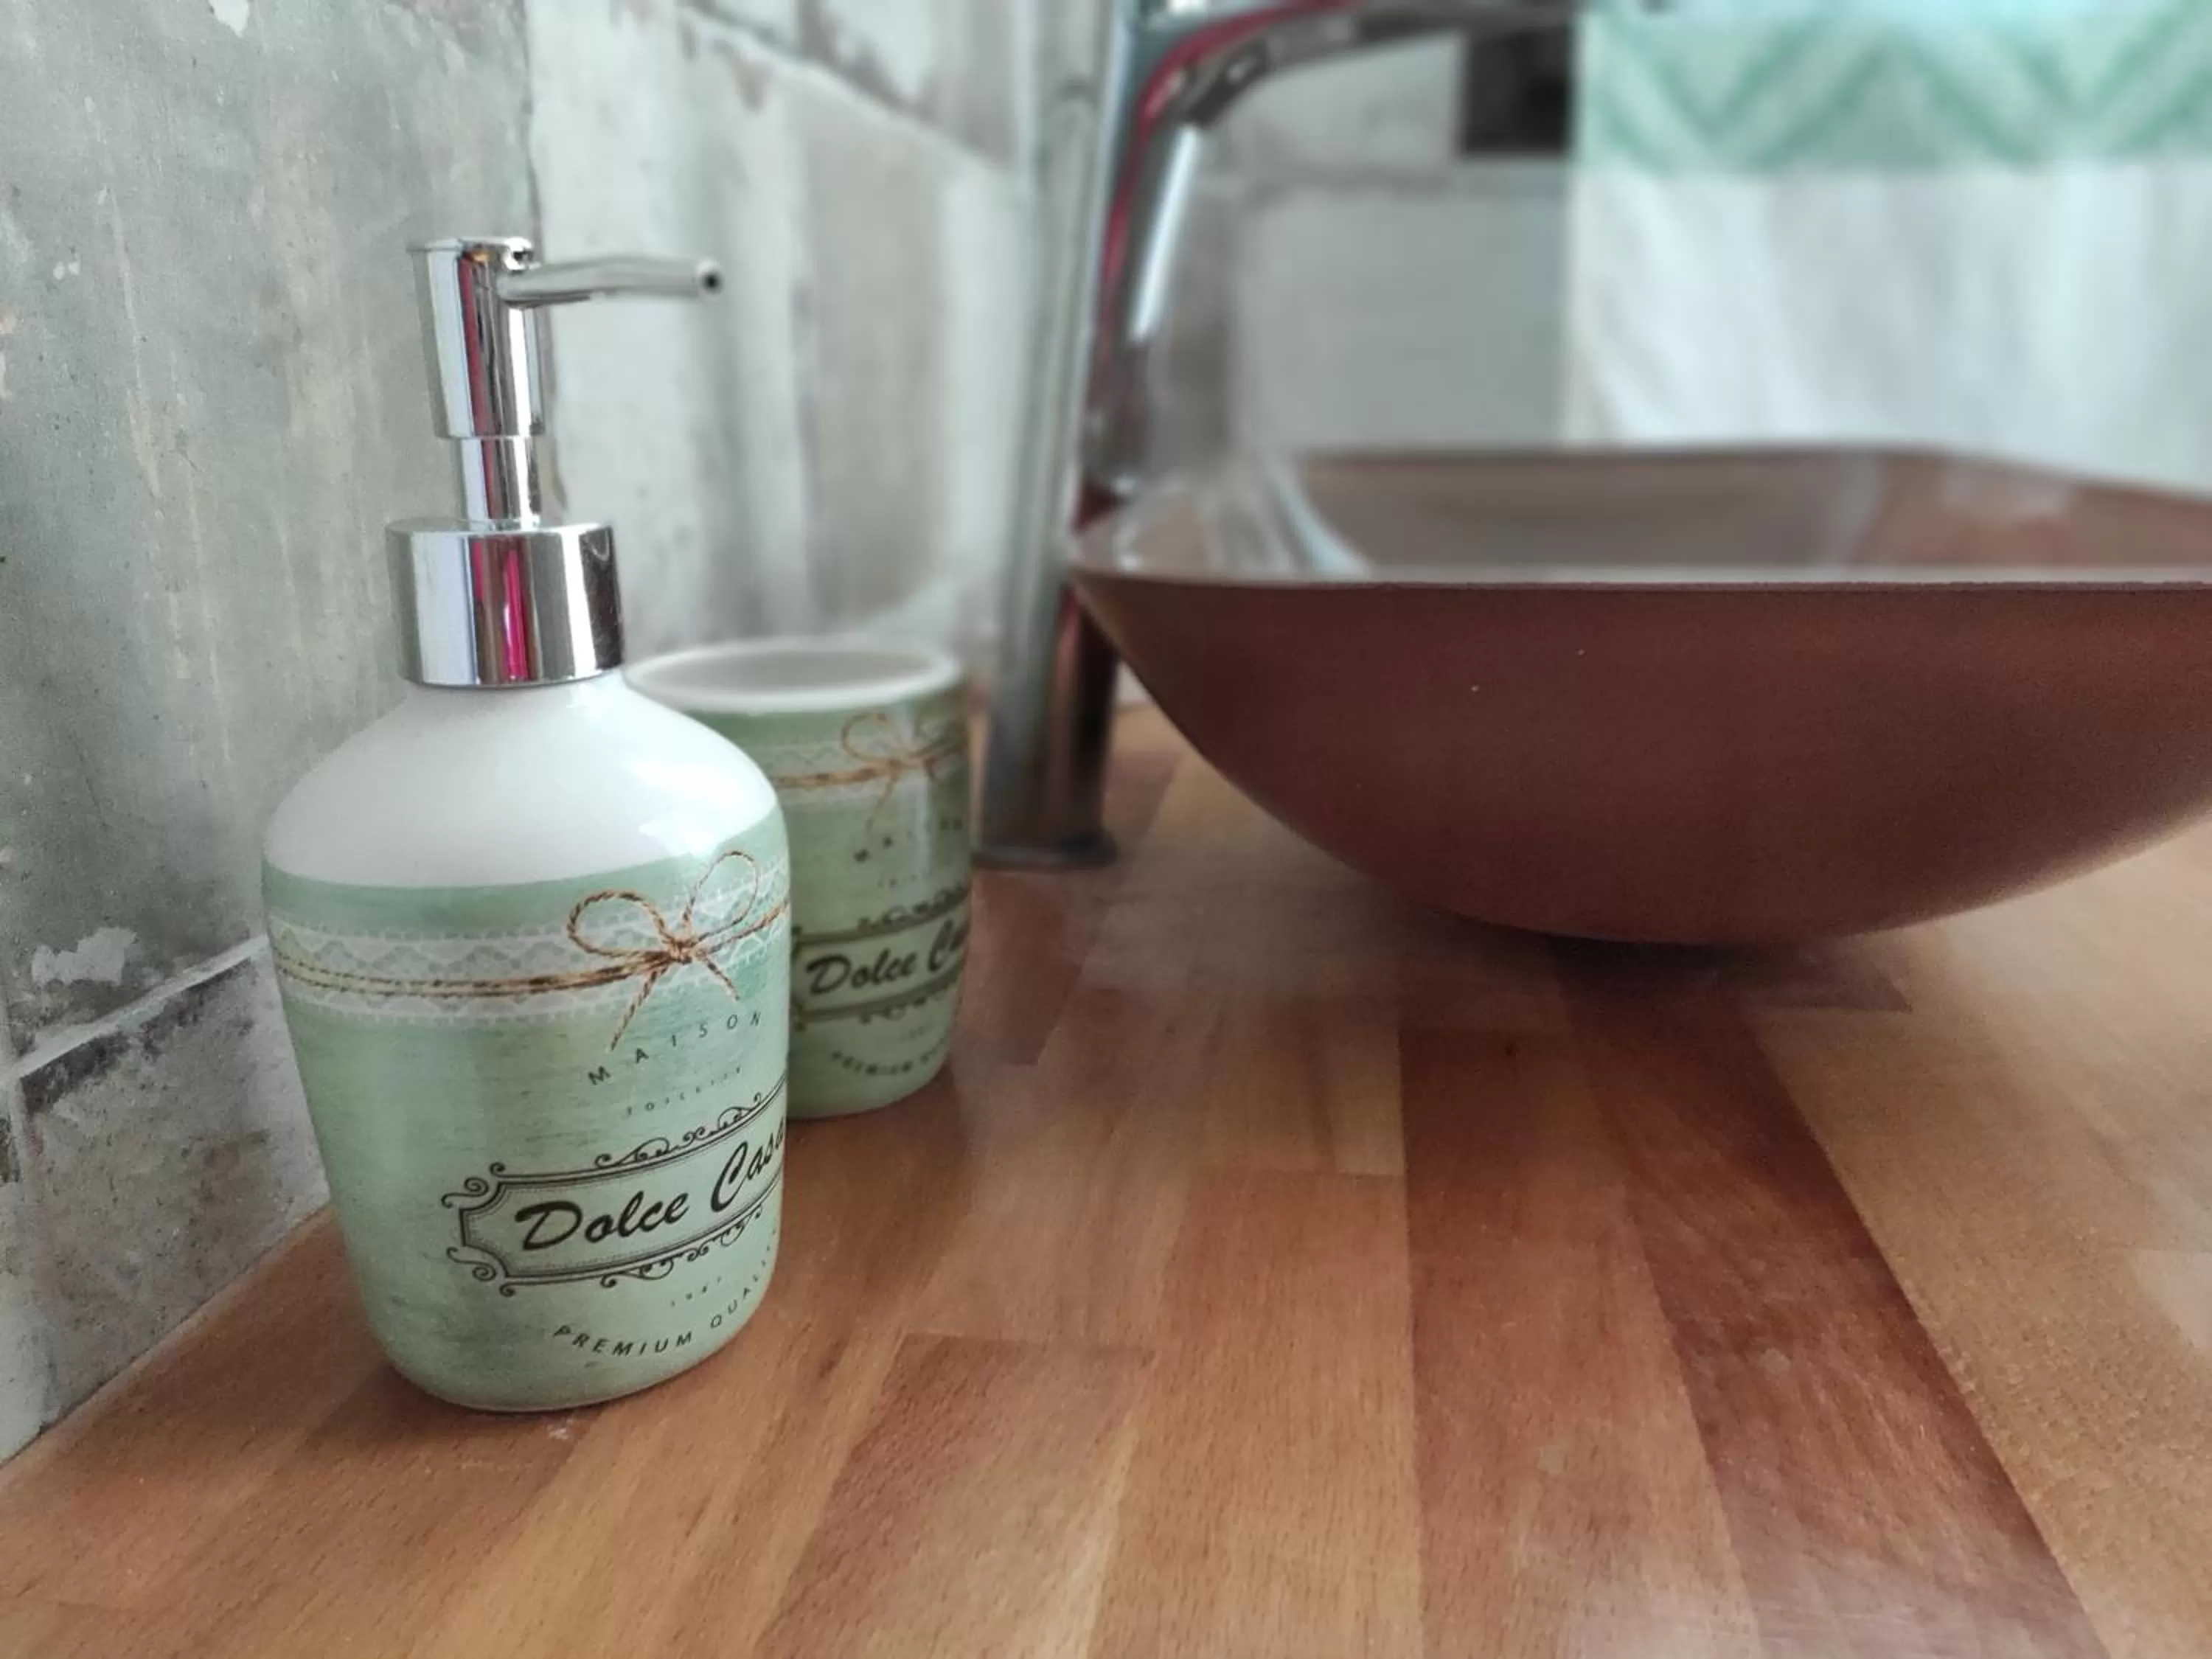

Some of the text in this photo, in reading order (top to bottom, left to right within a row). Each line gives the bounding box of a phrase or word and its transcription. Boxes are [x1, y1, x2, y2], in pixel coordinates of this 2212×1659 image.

[804, 947, 918, 996] Dolce
[587, 1011, 762, 1087] MAISON
[514, 1189, 690, 1252] Dolce
[552, 1324, 693, 1357] PREMIUM
